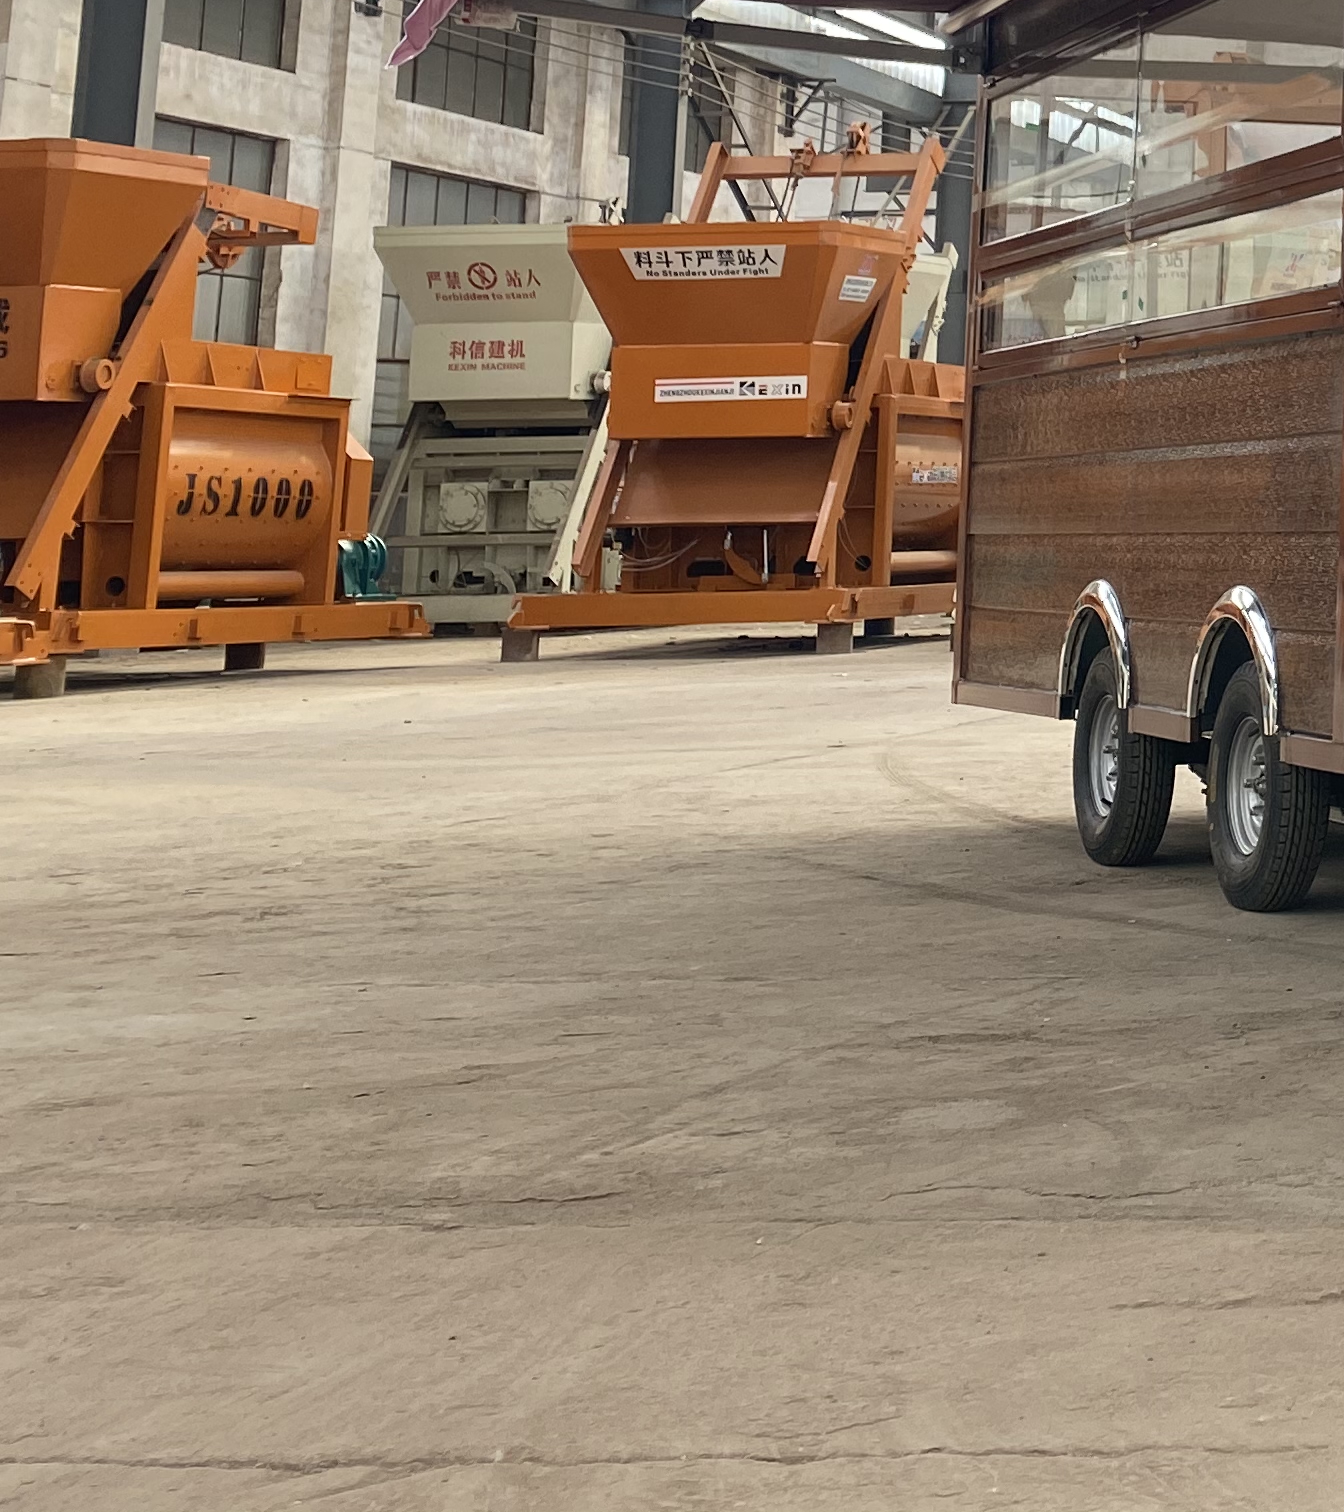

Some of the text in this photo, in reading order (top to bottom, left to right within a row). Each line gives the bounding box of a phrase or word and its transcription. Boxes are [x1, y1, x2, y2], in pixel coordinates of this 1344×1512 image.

[633, 248, 778, 269] 料斗下严禁站人
[426, 268, 541, 290] 严禁 站人
[646, 269, 660, 277] No
[709, 267, 740, 276] Under
[435, 289, 537, 302] Forbidden to stand
[449, 339, 526, 361] 科信建机
[448, 362, 526, 371] KEXIN MACHINE
[176, 472, 315, 520] JS1000
